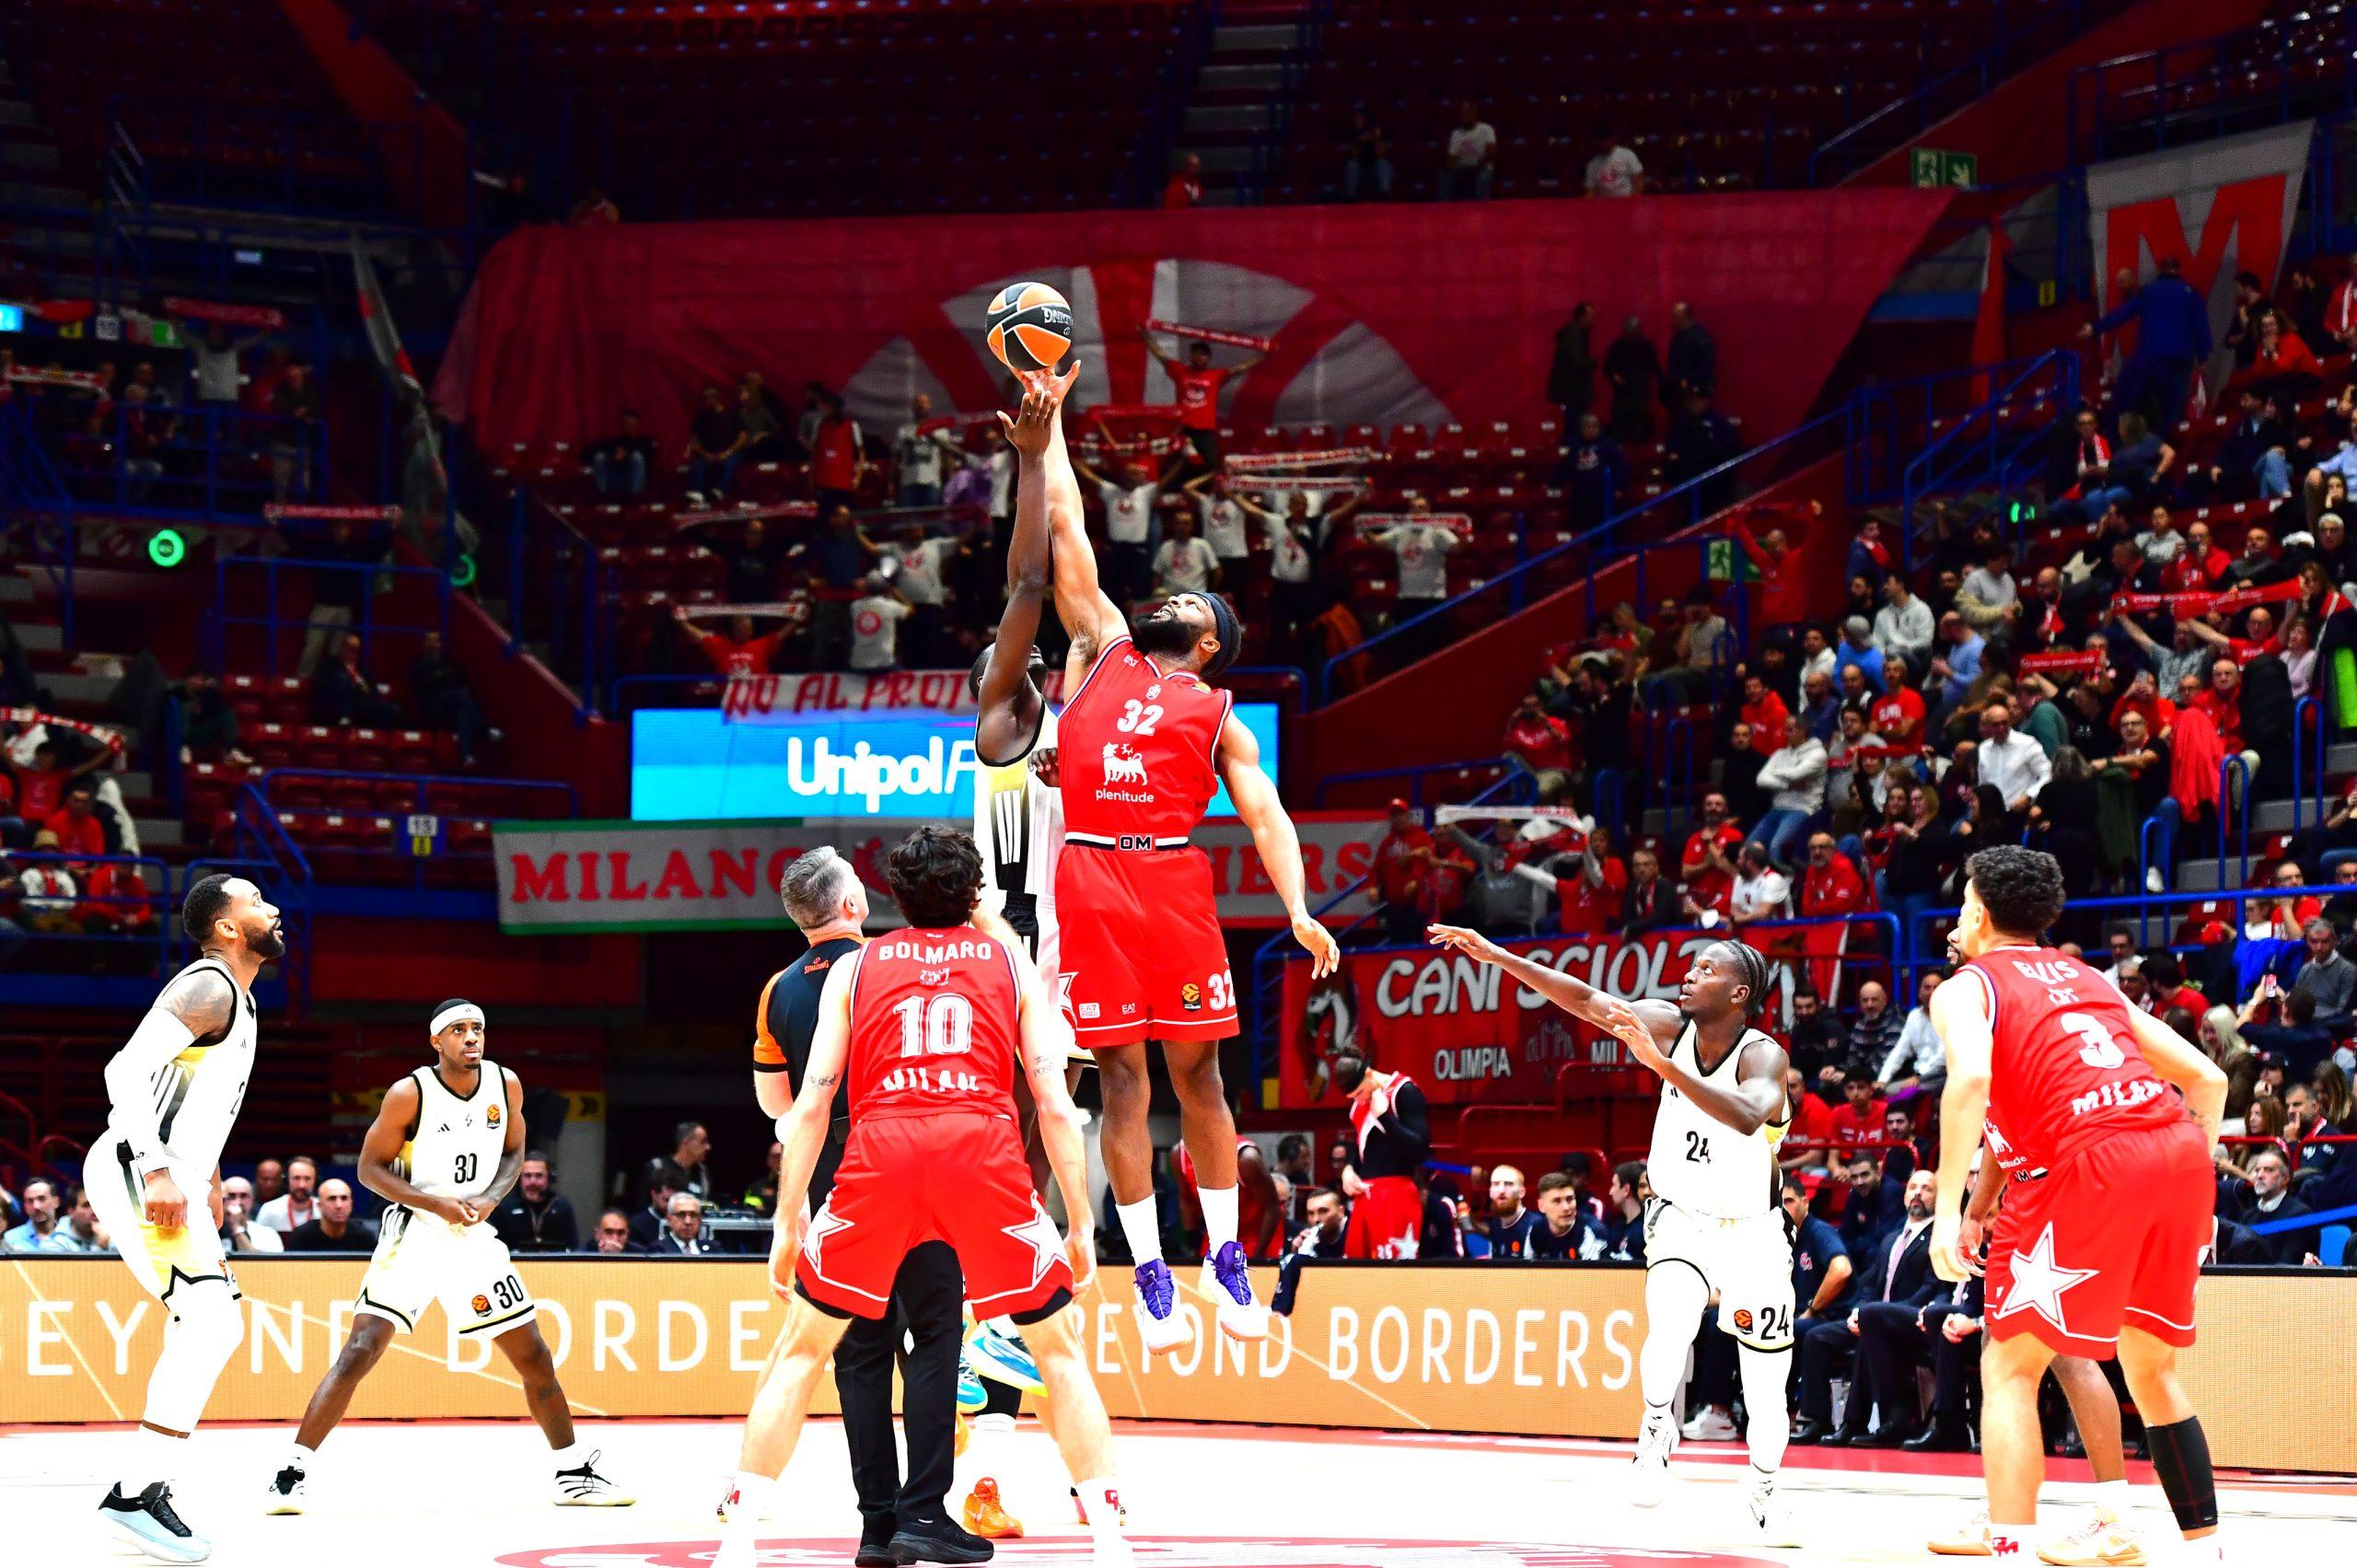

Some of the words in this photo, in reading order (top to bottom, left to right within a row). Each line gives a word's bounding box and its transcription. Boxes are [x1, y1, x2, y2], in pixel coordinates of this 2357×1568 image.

[724, 673, 779, 717] NO
[794, 674, 849, 714] AL
[860, 671, 979, 712] PROT
[1117, 699, 1164, 736] 32
[1096, 788, 1155, 804] plenitude
[1120, 836, 1151, 851] OM
[510, 848, 808, 903] MILANO
[804, 959, 829, 974] SPALDING
[878, 941, 992, 965] BOLMARO
[1376, 954, 1504, 1018] CANI
[1515, 936, 1724, 1010] SCIOLT
[893, 992, 972, 1058] 10
[2061, 1012, 2126, 1069] 3
[1434, 1047, 1512, 1080] OLIMPIA
[1590, 1040, 1641, 1072] MILA
[1686, 1130, 1712, 1165] 24
[454, 1153, 478, 1184] 30
[2014, 1168, 2031, 1182] M
[493, 1274, 525, 1309] 30
[447, 1298, 772, 1373] BORDE
[1760, 1304, 1790, 1341] 24
[1073, 1302, 1293, 1378] EYOND
[1329, 1305, 1634, 1391] BORDERS
